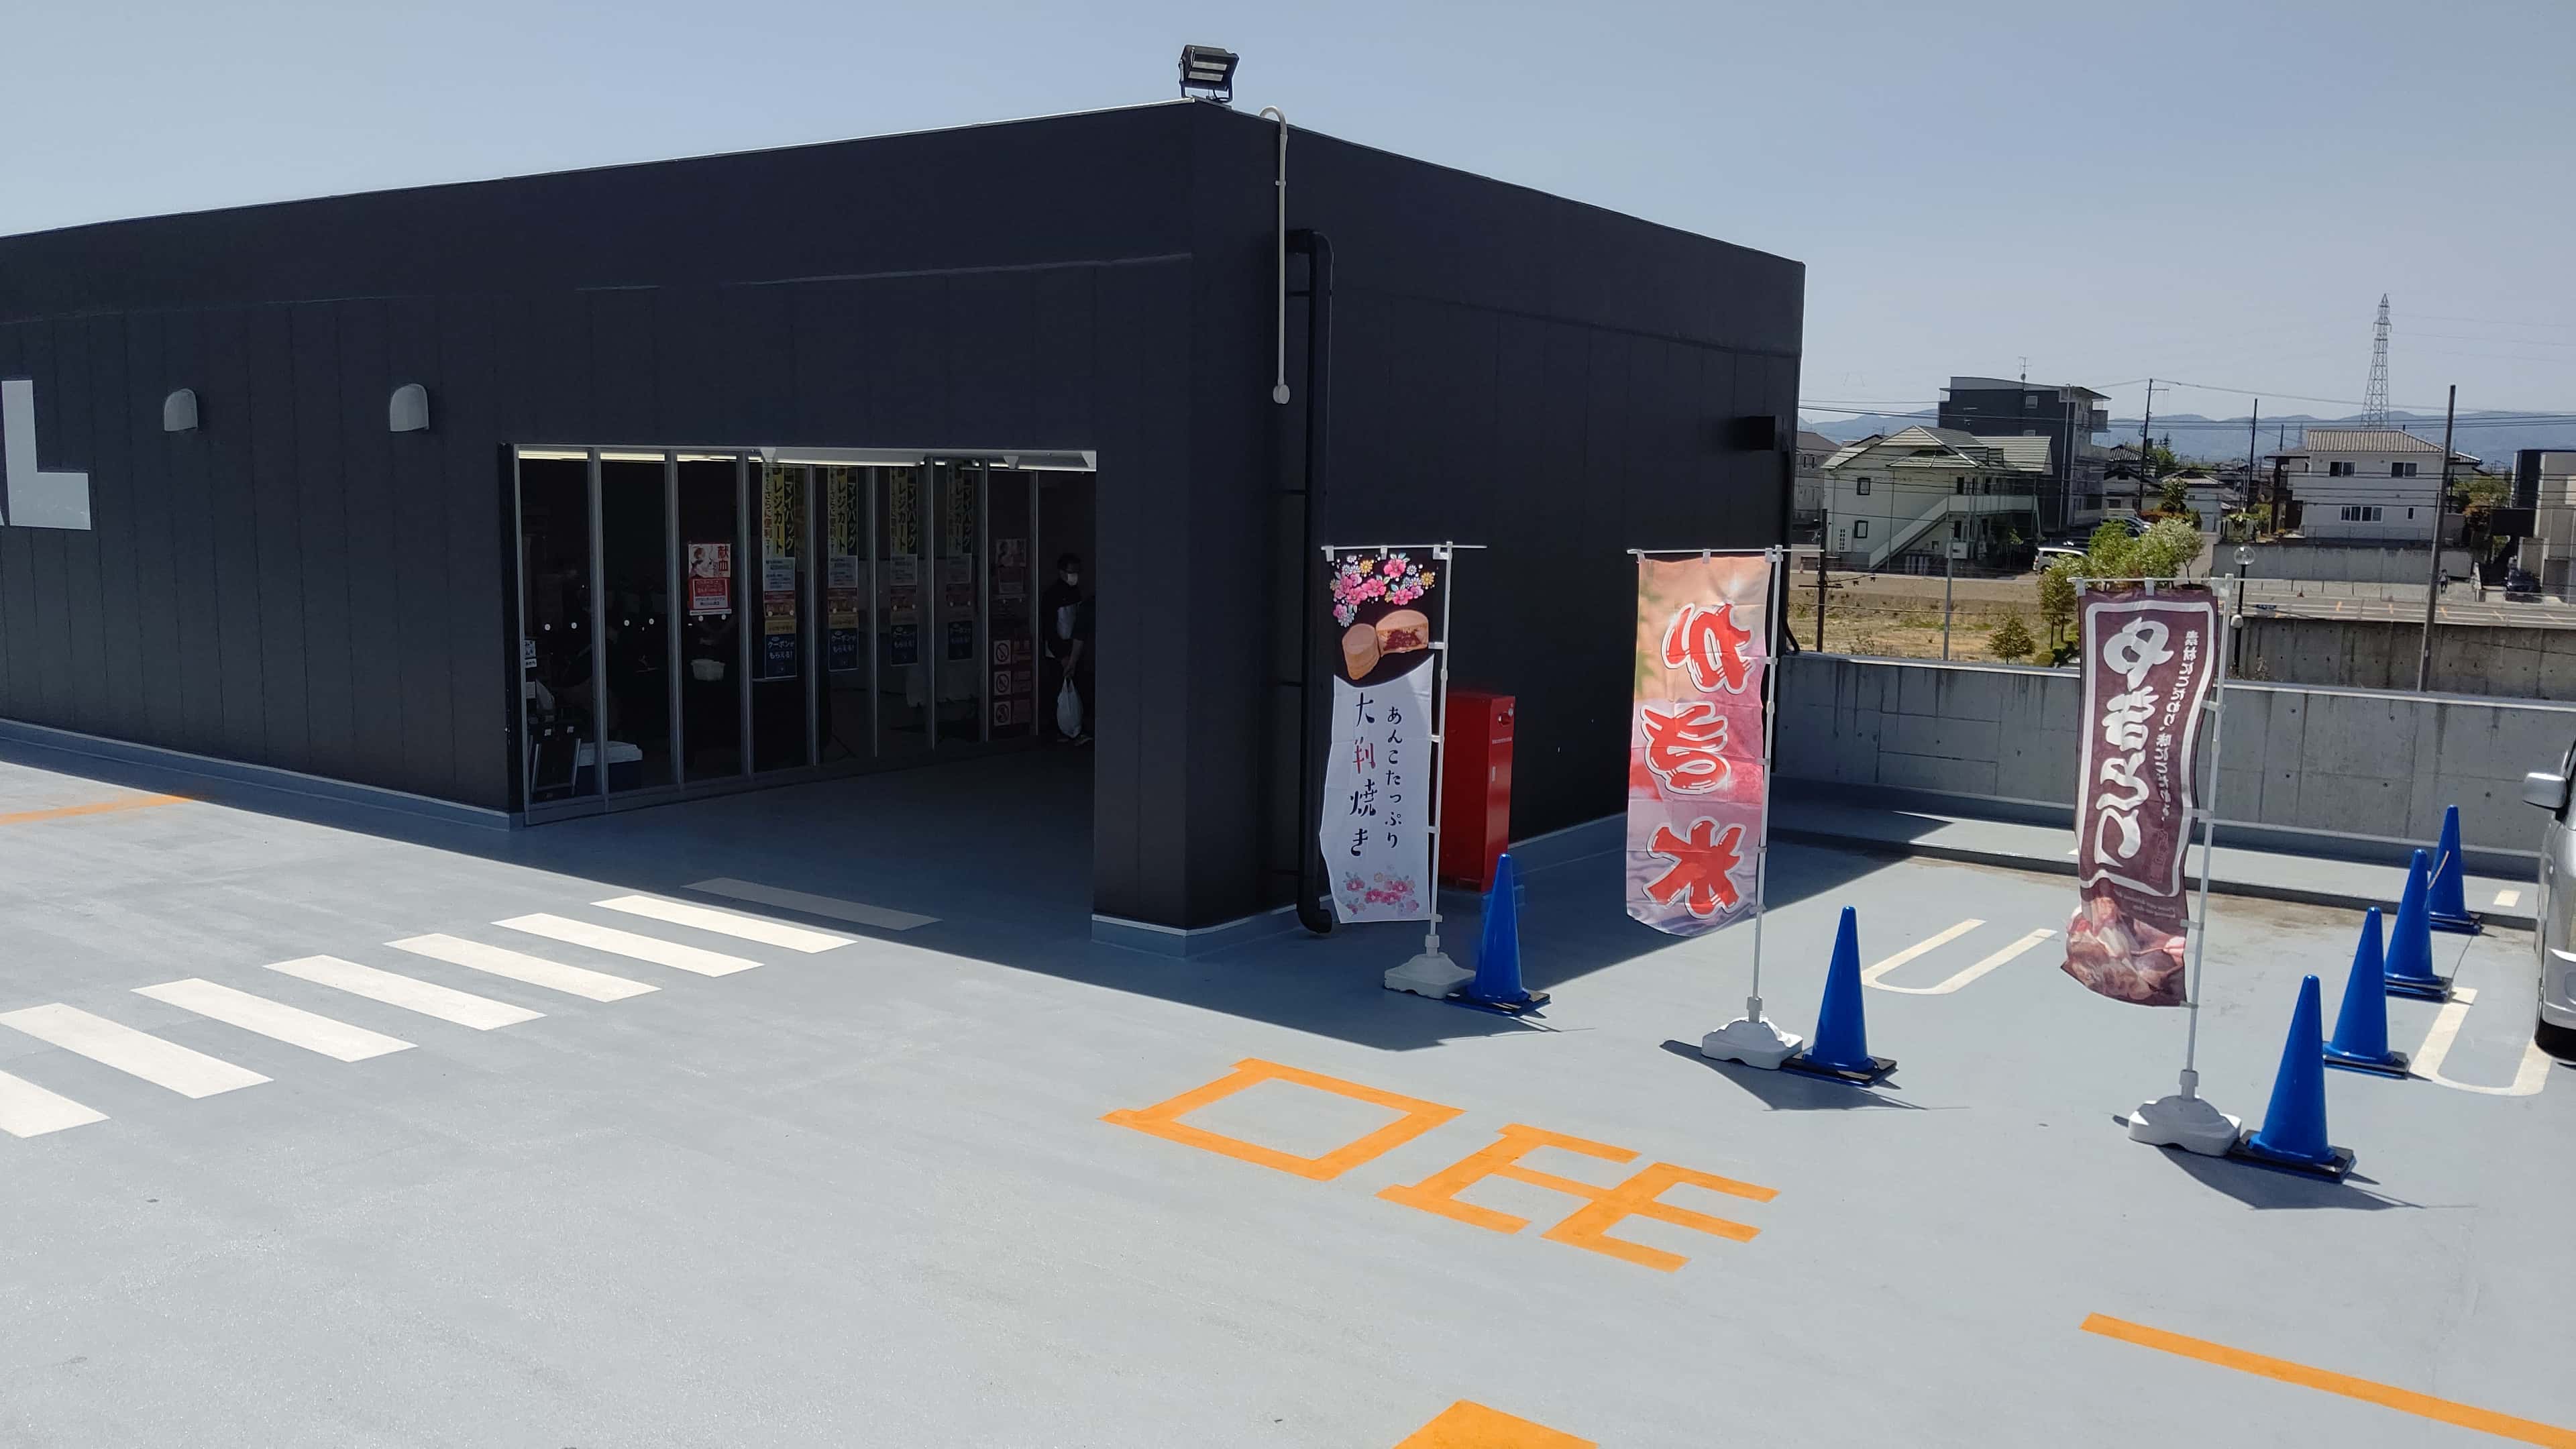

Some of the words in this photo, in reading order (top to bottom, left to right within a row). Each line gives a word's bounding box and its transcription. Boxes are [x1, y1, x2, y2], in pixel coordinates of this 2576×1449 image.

[0, 380, 91, 530] L
[1349, 692, 1378, 857] 大判焼き
[1384, 706, 1403, 849] あんこたっぷり
